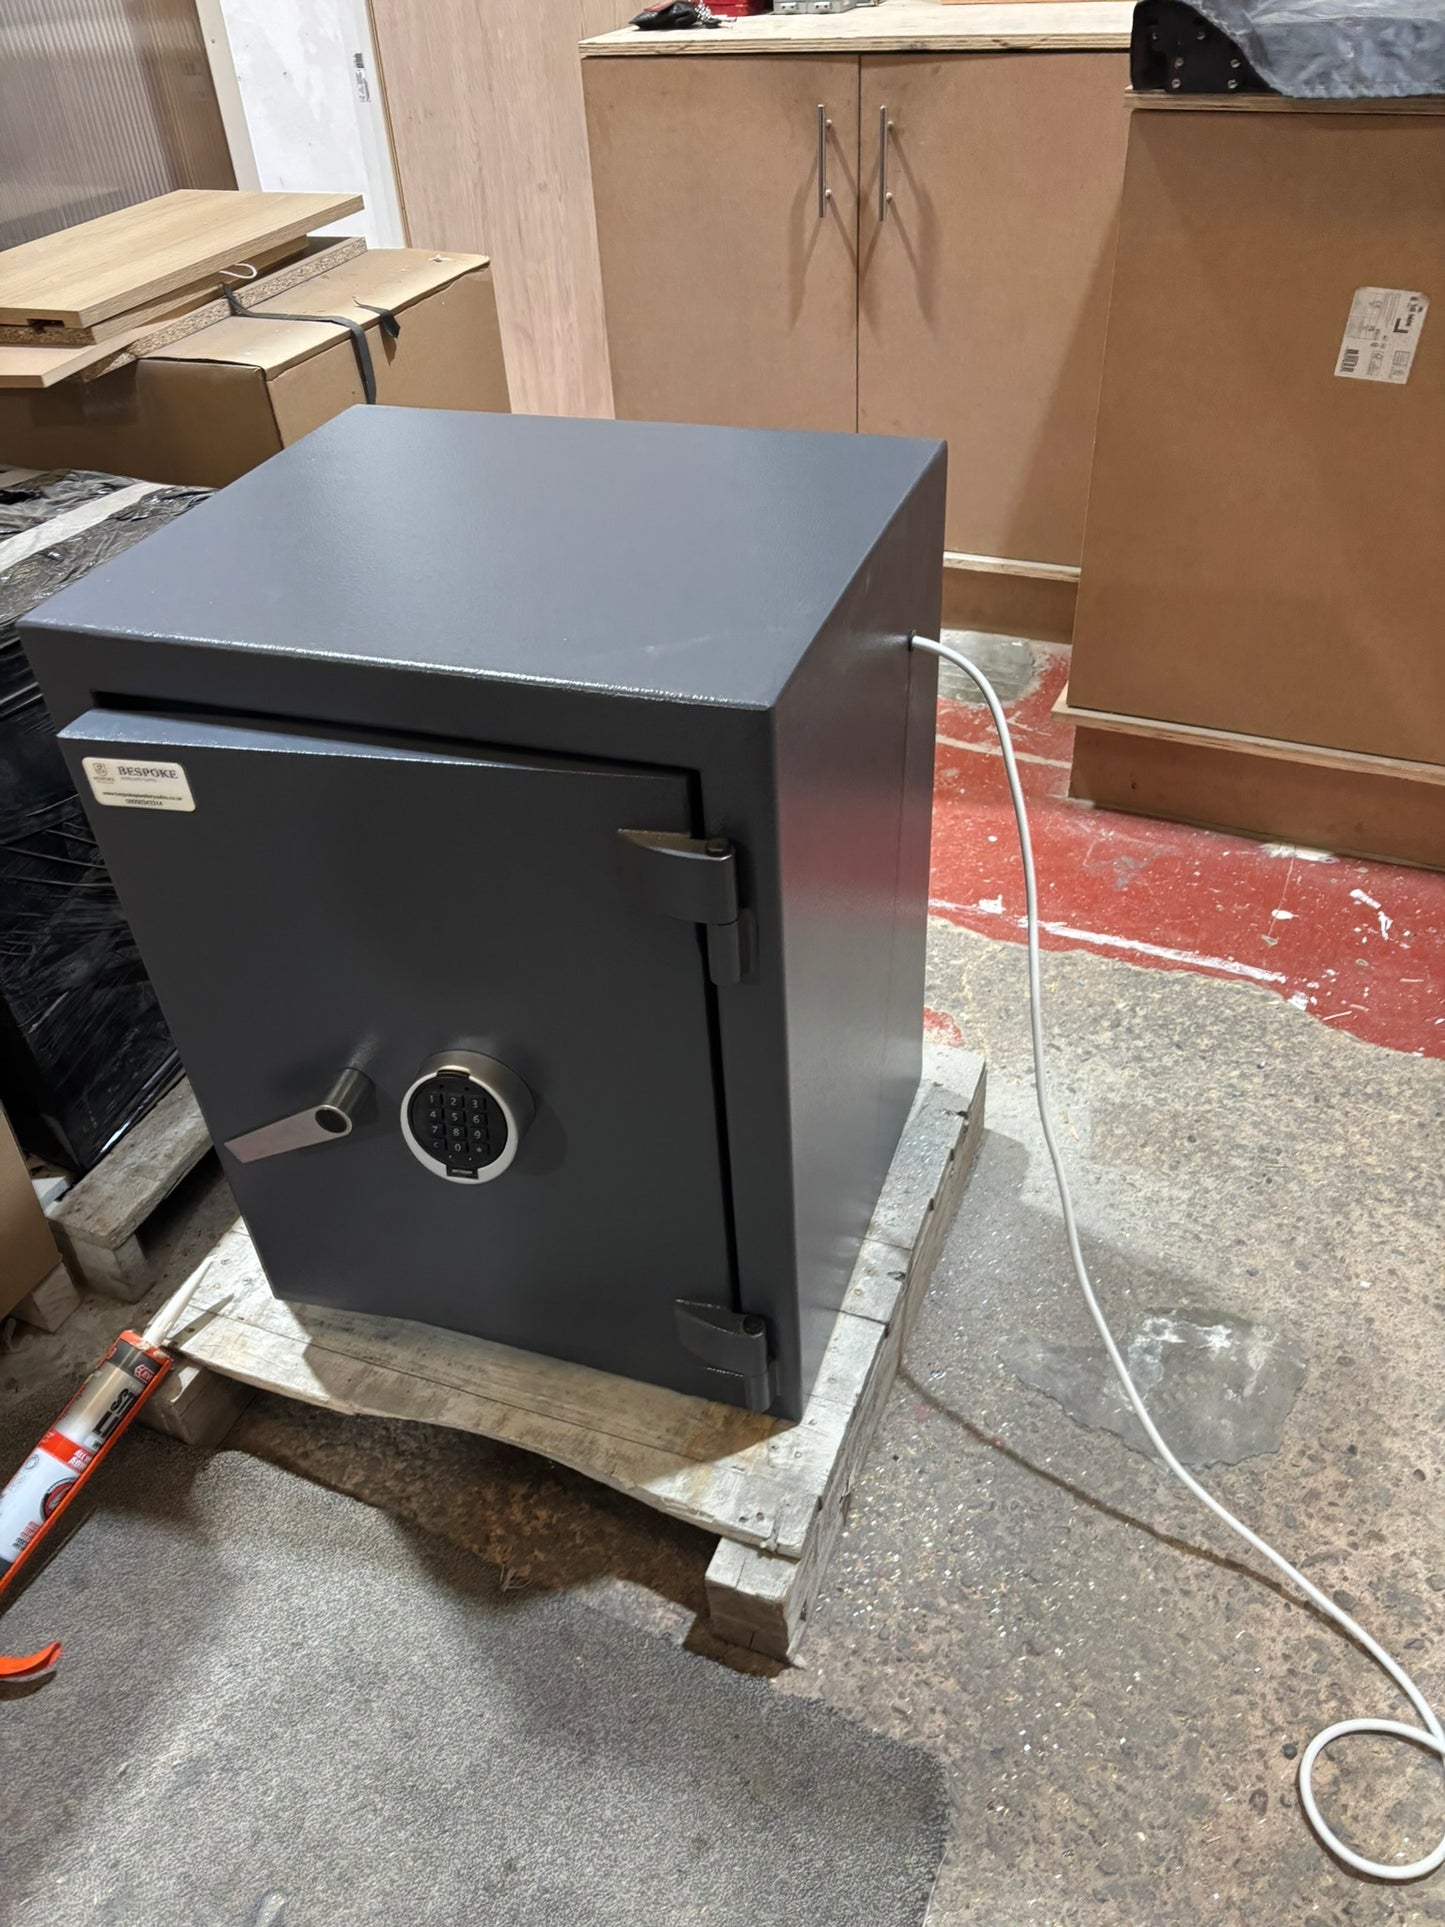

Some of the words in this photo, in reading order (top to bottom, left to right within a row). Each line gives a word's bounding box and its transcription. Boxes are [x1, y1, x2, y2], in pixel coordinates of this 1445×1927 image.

[117, 766, 179, 779] BESPOKE
[450, 1097, 457, 1106] 2
[472, 1100, 479, 1109] 3
[451, 1112, 458, 1121] 5
[473, 1115, 480, 1124] 6
[431, 1126, 438, 1134] 7
[452, 1128, 460, 1137] 8
[474, 1130, 481, 1139] 9
[454, 1143, 462, 1152] 0
